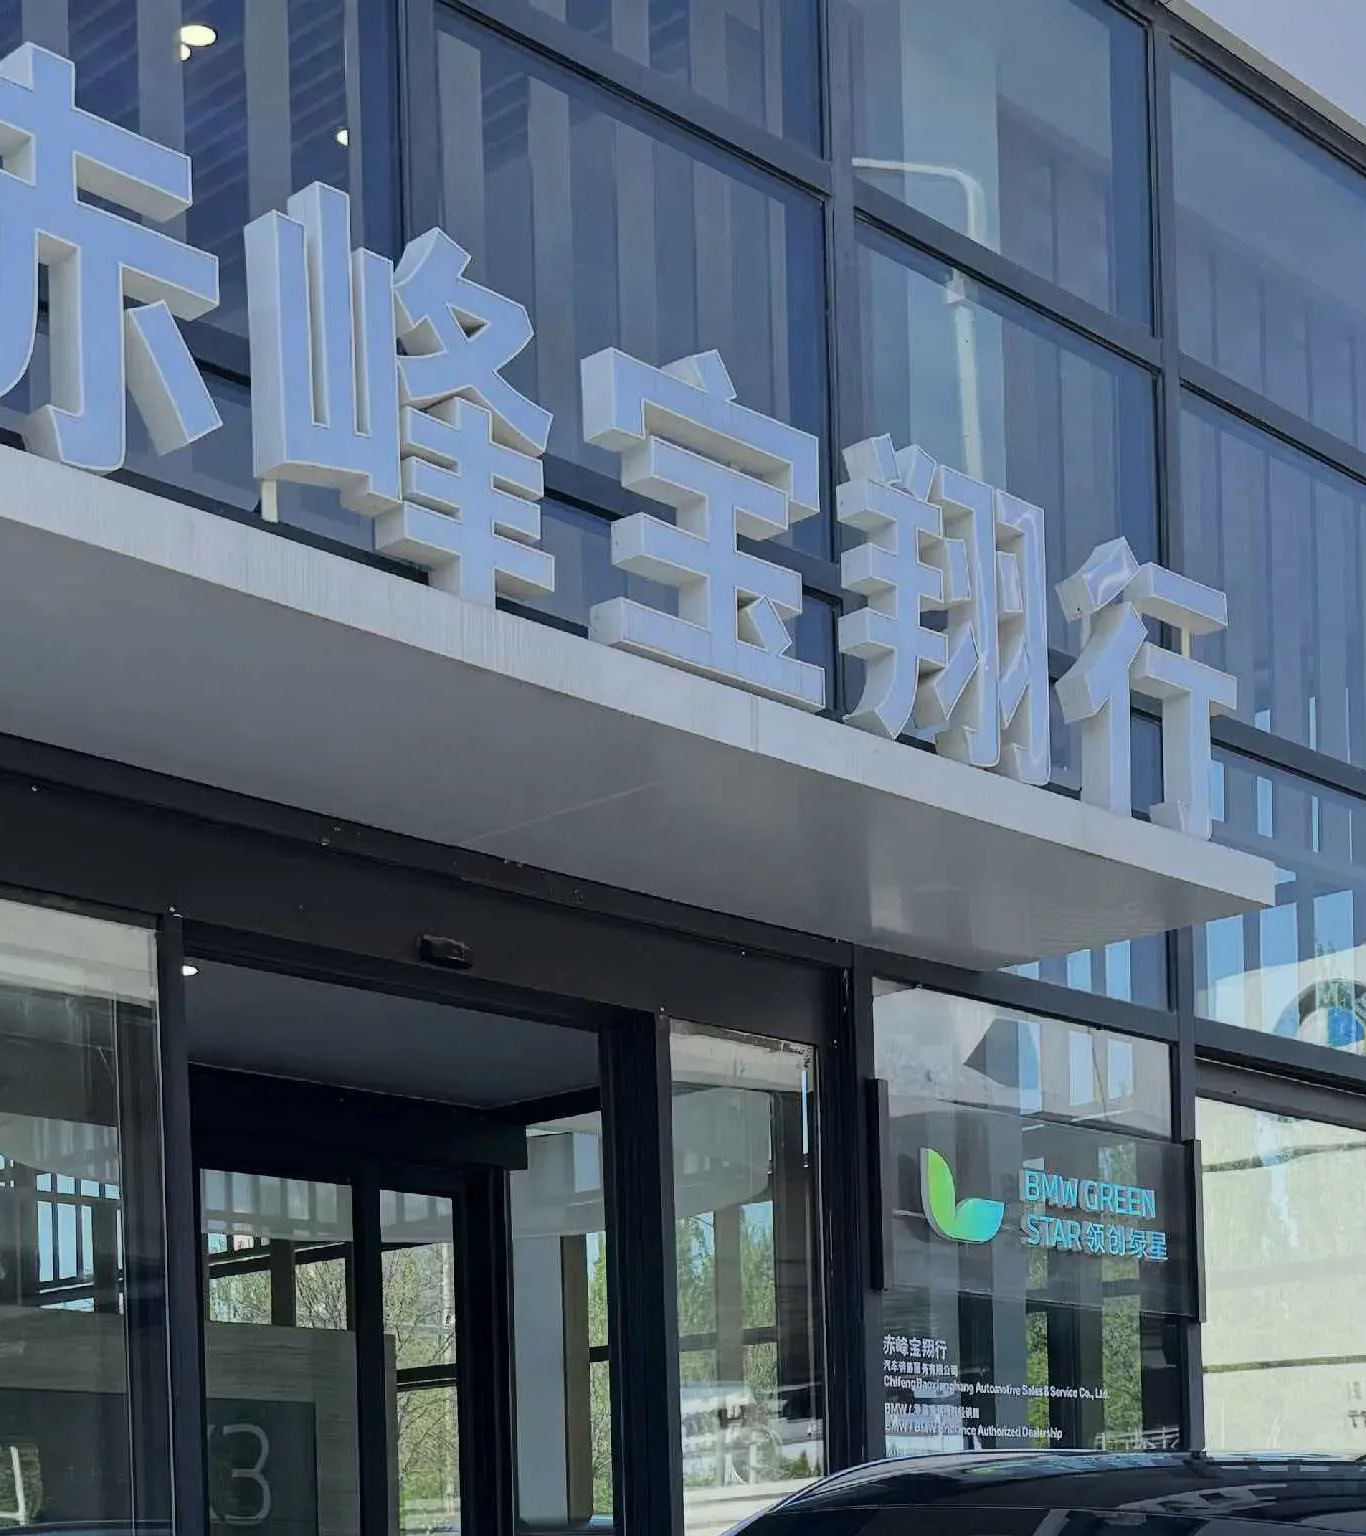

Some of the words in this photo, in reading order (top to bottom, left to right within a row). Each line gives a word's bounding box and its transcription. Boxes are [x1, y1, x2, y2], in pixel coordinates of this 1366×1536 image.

[1019, 1169, 1078, 1208] BMW
[1079, 1180, 1155, 1220] GREEN
[1020, 1214, 1082, 1252] STAR
[1083, 1221, 1168, 1262] 领创绿星
[882, 1334, 947, 1361] 赤峰宝翔行
